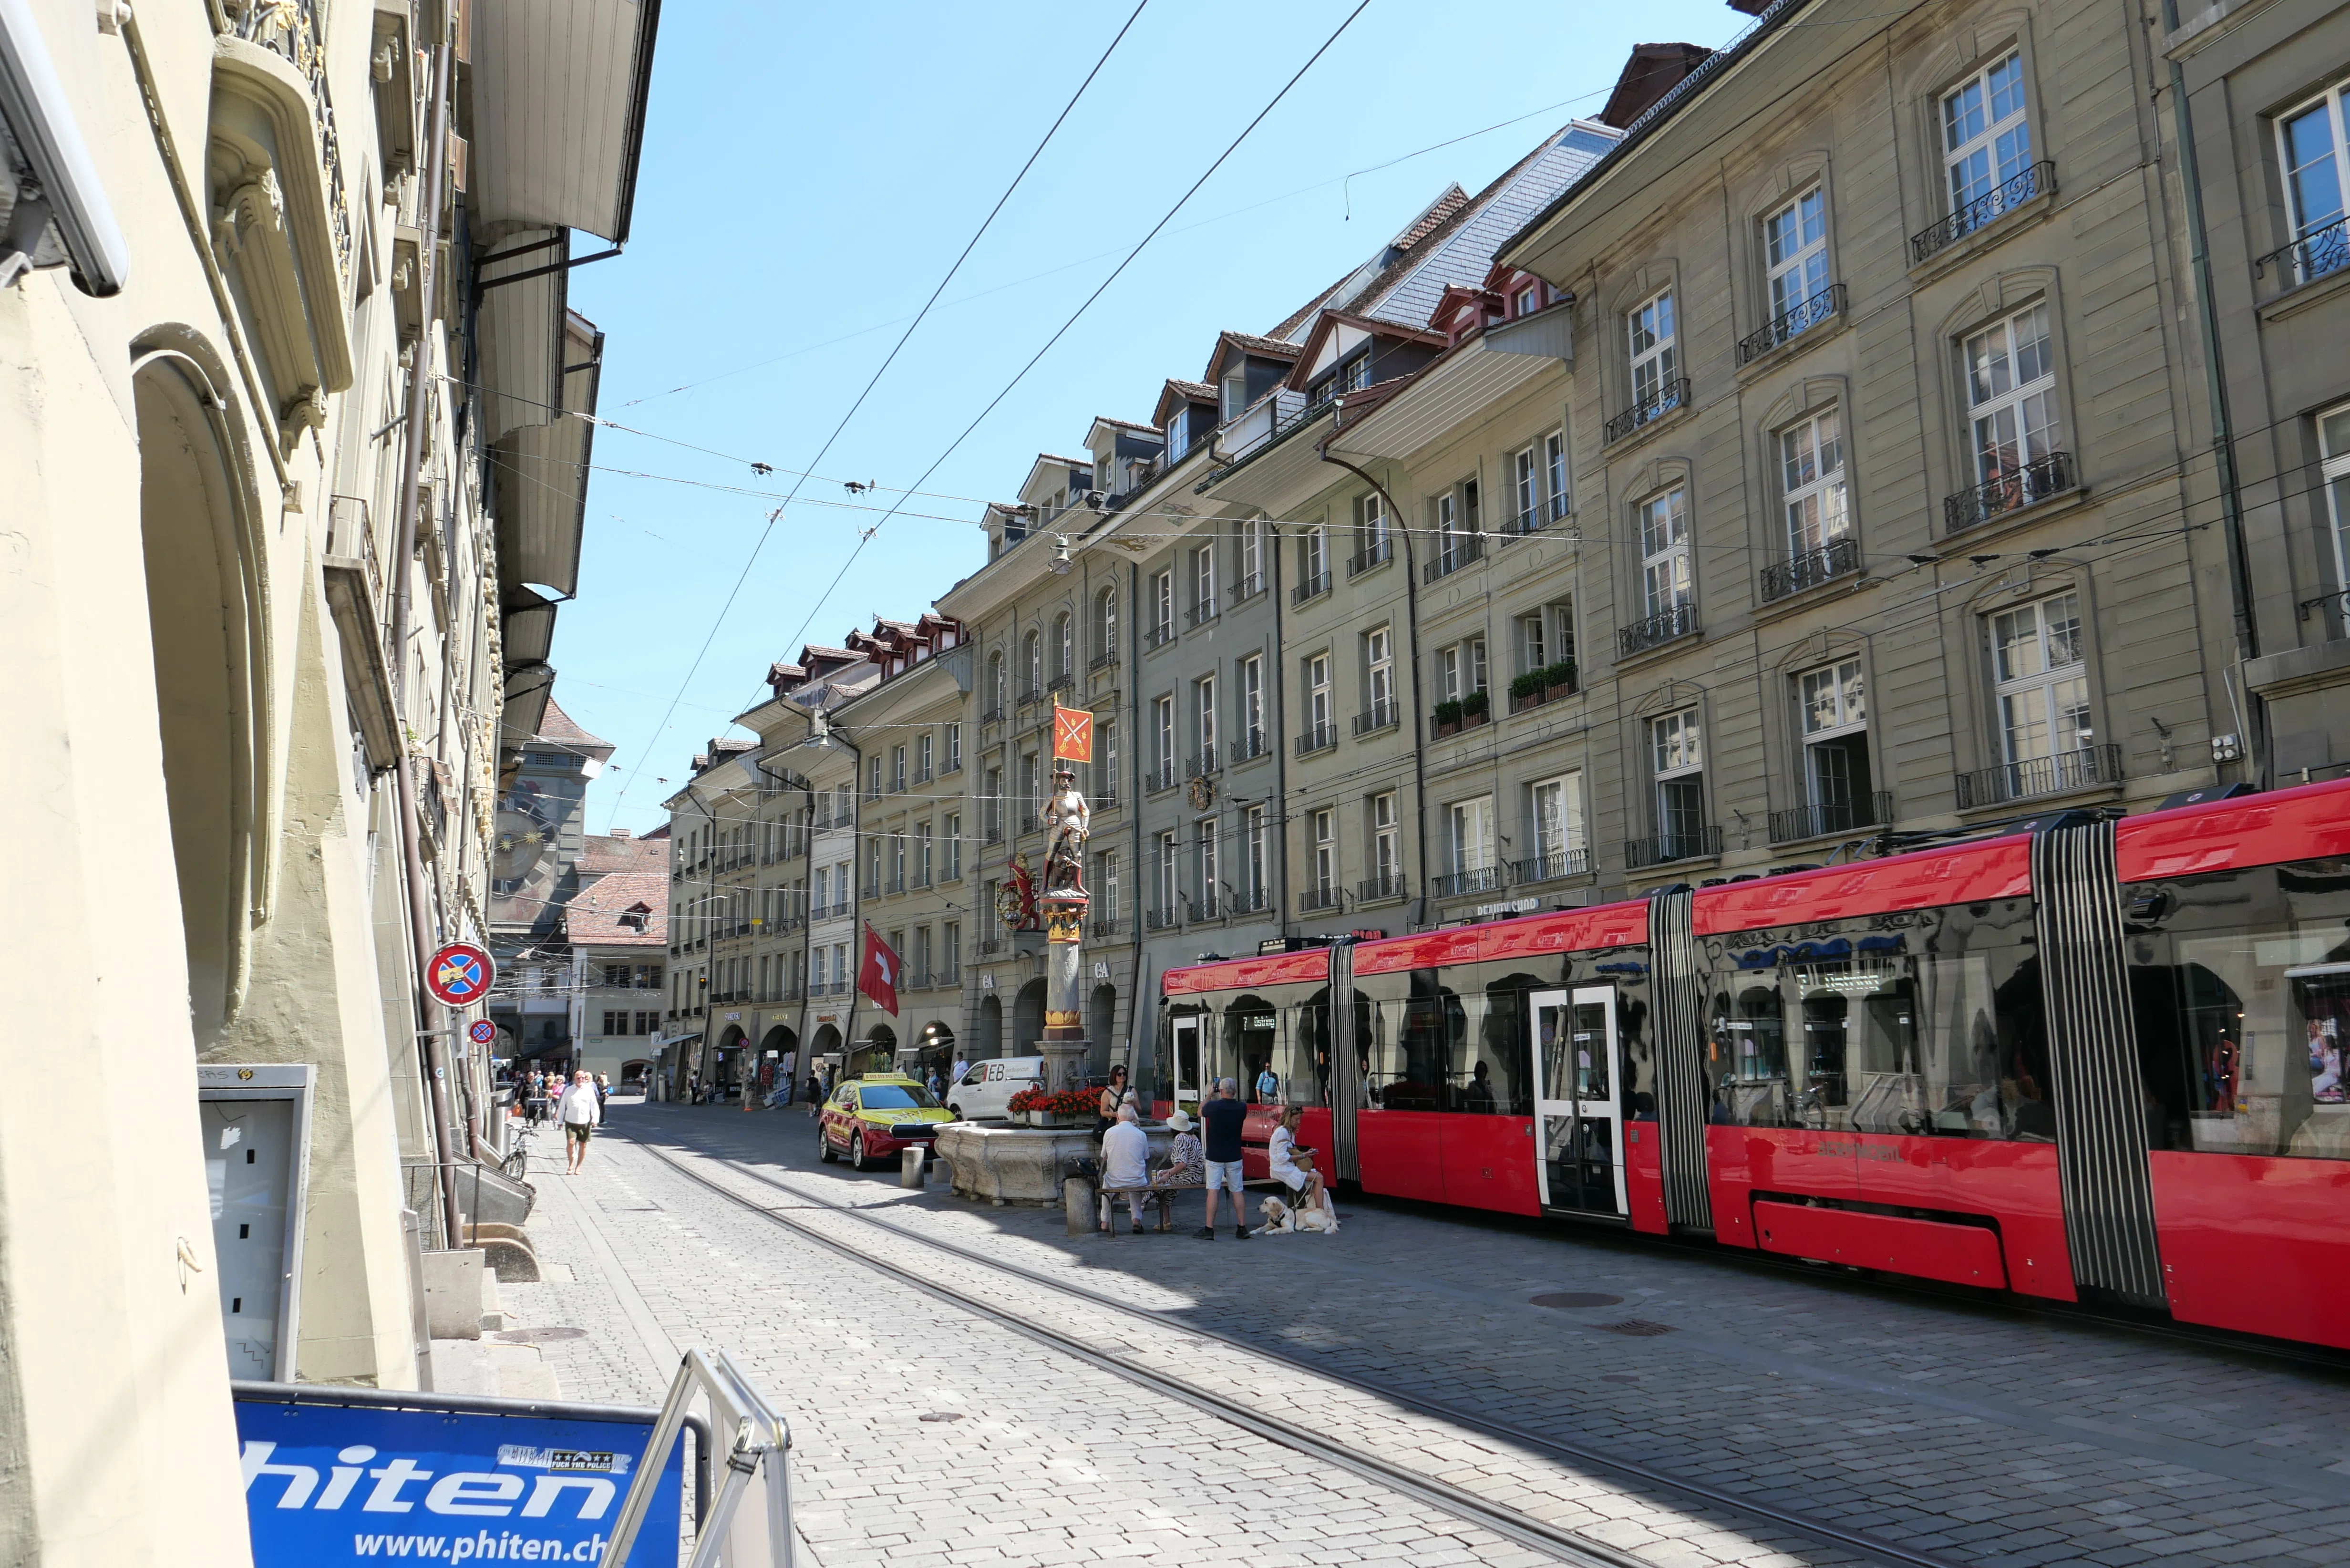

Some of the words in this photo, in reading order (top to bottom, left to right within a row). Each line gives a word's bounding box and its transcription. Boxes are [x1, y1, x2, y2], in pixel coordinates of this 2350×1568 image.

[1477, 902, 1510, 916] BEAUTY
[1511, 897, 1540, 912] SHOP
[1095, 961, 1109, 978] C&A
[1254, 1015, 1275, 1029] Ostring
[988, 1063, 1005, 1082] EB
[1818, 1141, 1904, 1163] BERNMOBIL
[354, 1529, 608, 1565] www.phiten.ch
